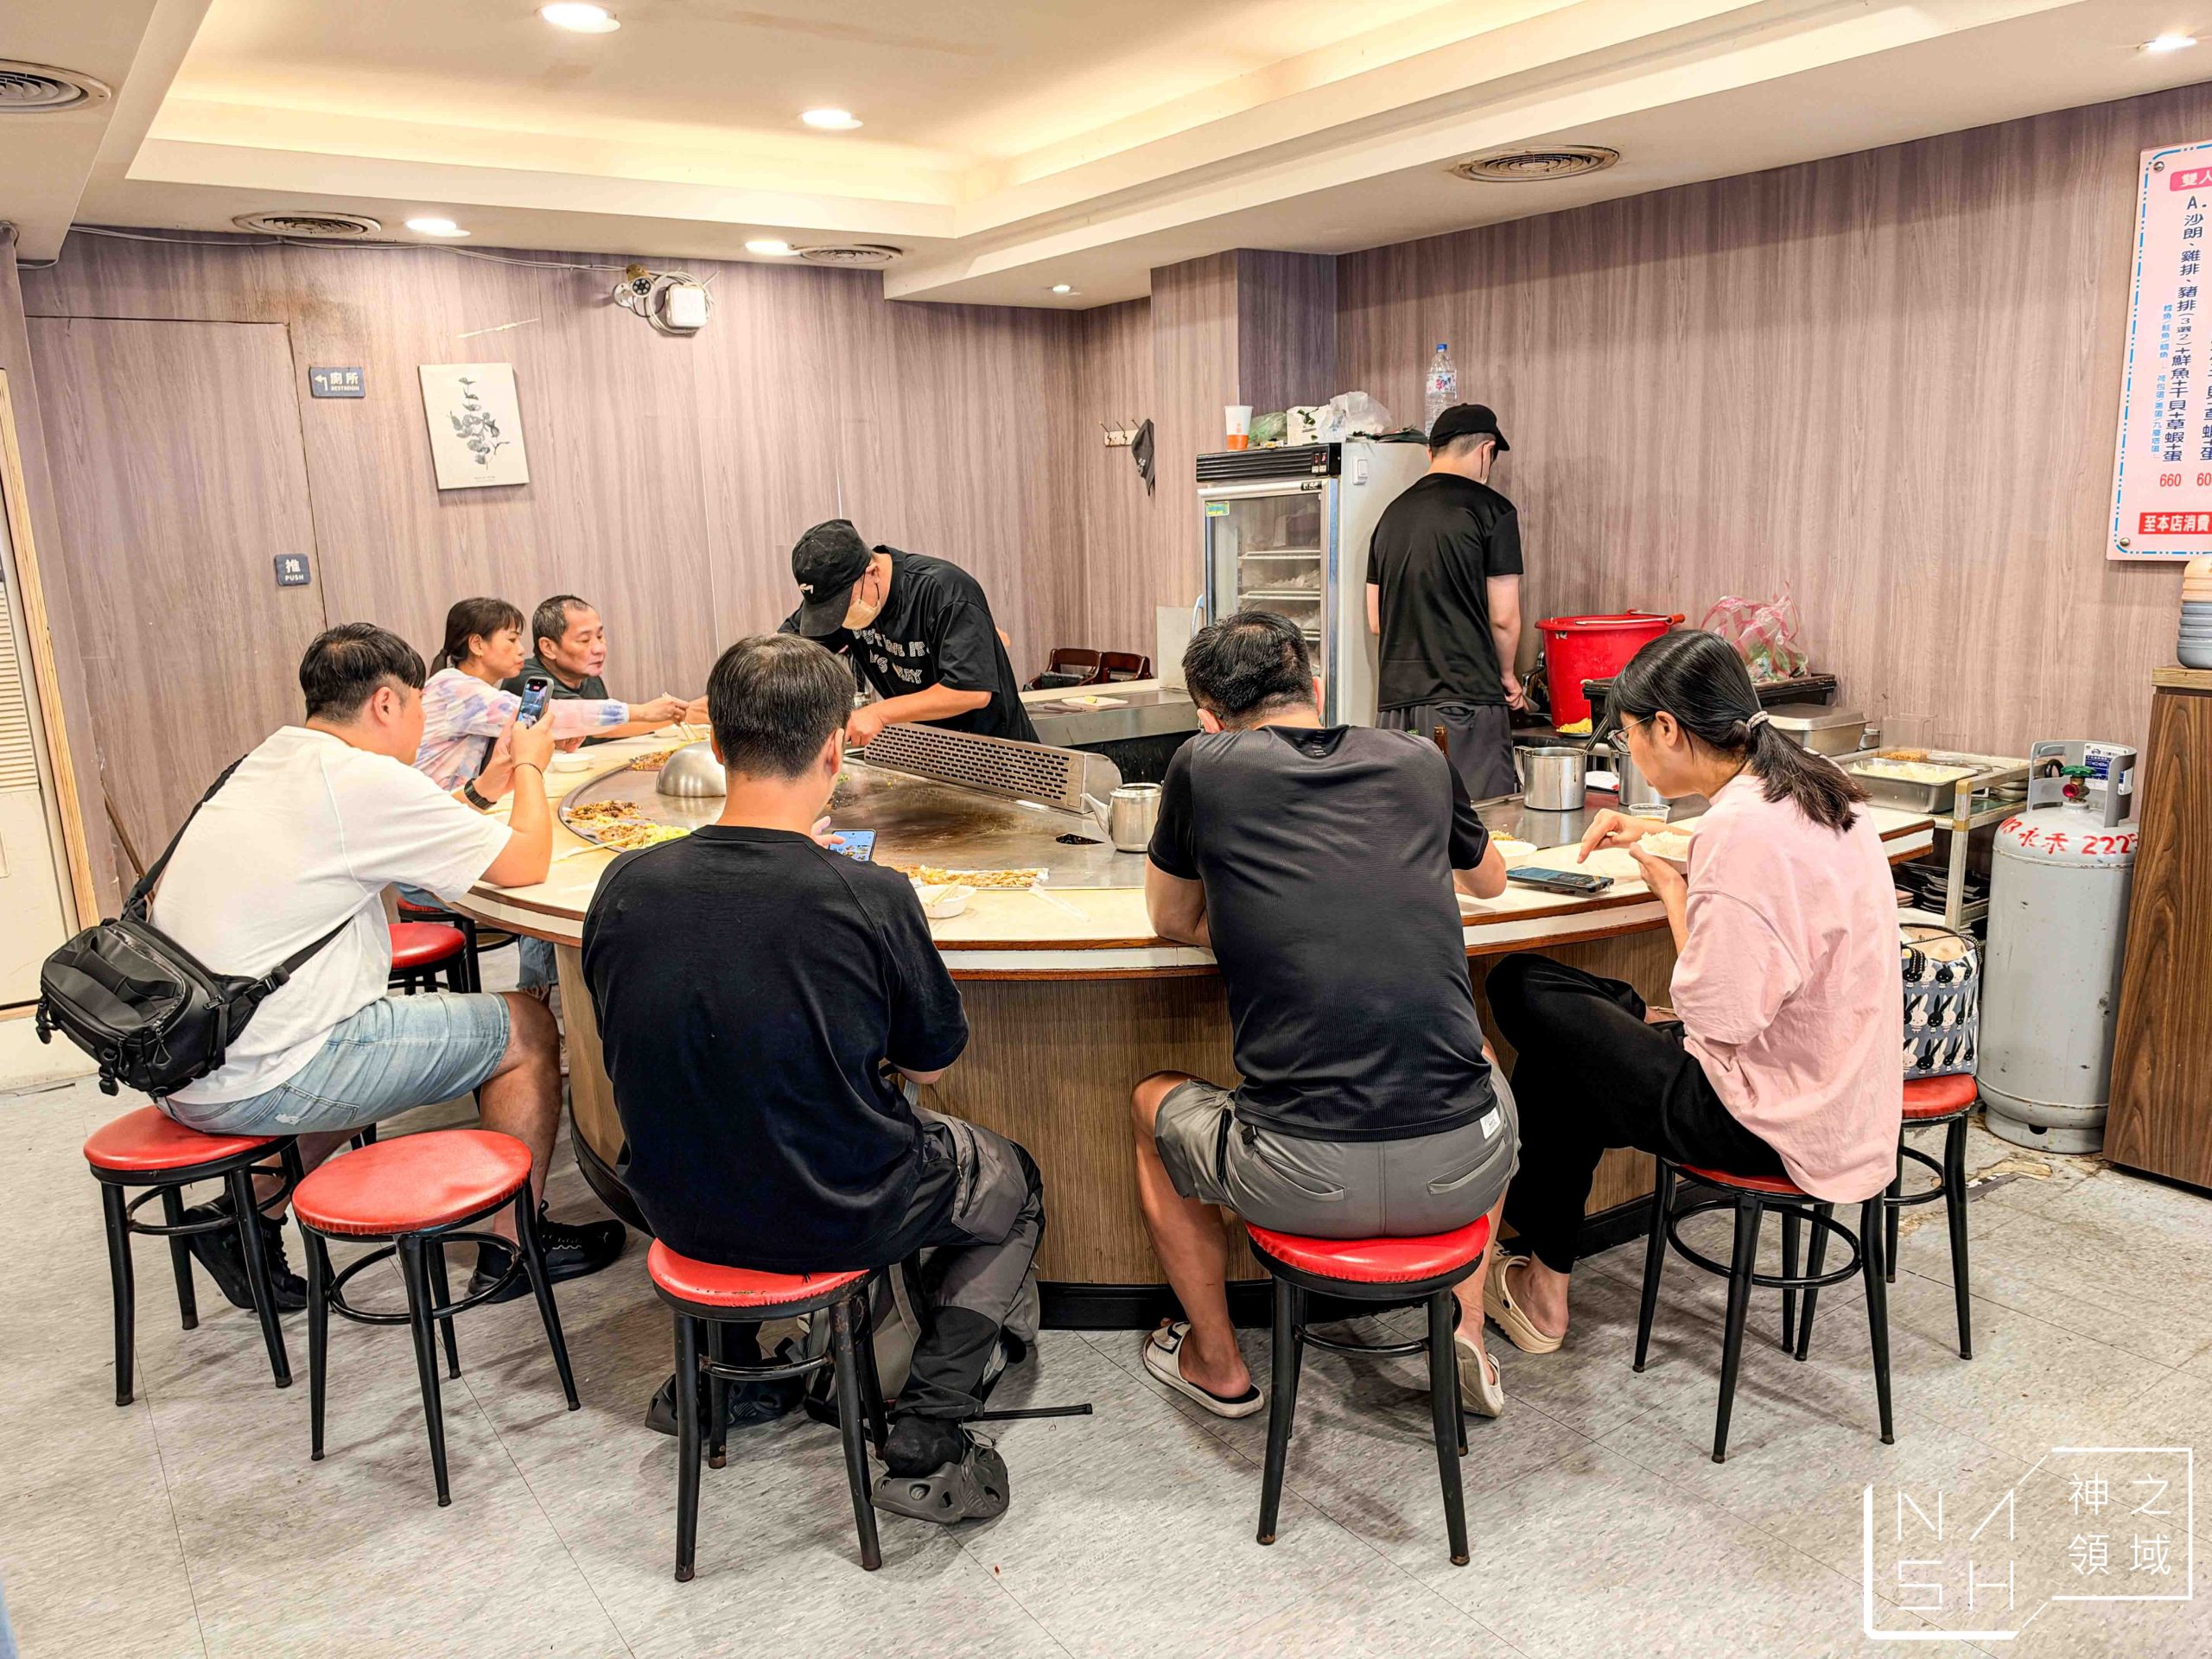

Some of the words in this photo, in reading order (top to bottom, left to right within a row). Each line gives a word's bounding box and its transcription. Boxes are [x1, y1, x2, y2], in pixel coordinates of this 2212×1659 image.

[330, 372, 359, 385] 廁所
[2159, 473, 2182, 487] 660
[2143, 514, 2210, 532] 至本店消費
[285, 558, 302, 574] 推
